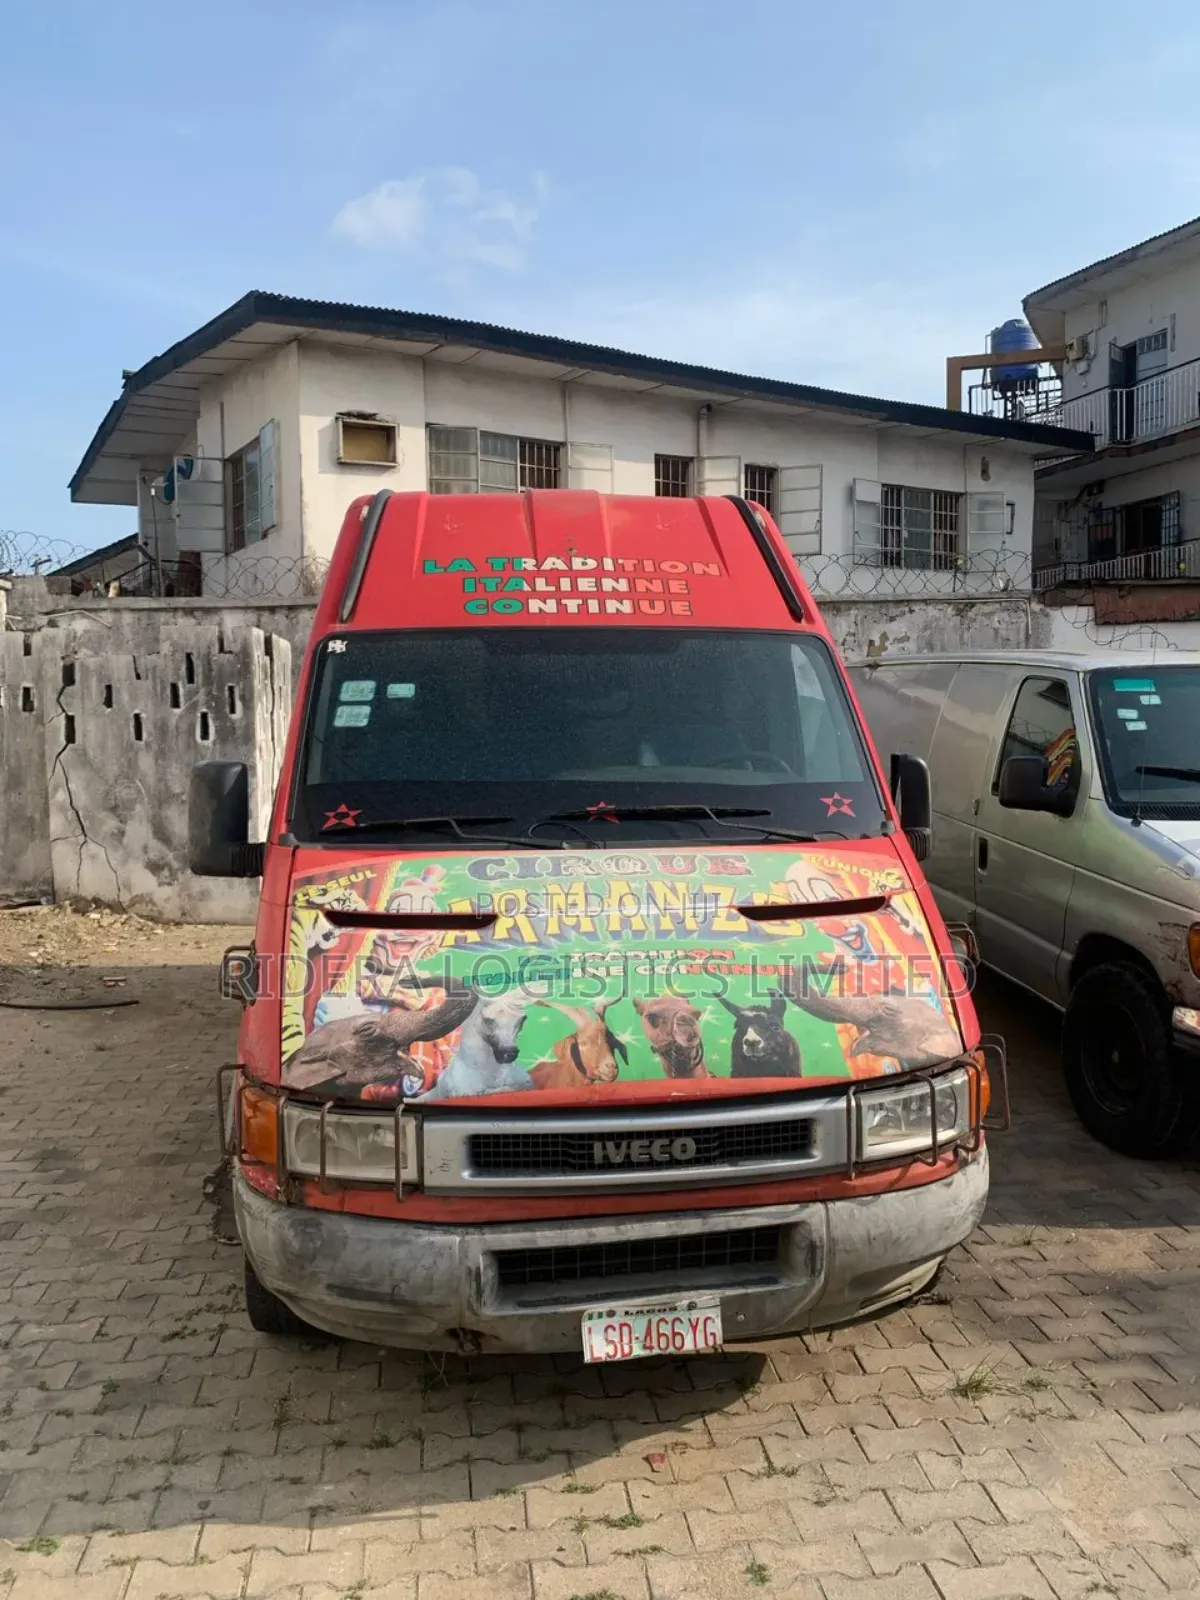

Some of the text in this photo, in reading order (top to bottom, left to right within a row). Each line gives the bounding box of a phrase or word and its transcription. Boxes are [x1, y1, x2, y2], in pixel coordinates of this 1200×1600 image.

[422, 556, 722, 577] LA TRADITION
[461, 577, 690, 595] ITALIENNE
[463, 598, 694, 616] CONTINUE
[467, 853, 755, 880] CIRQUE
[325, 869, 377, 891] SEUL
[593, 1136, 697, 1164] IVECO
